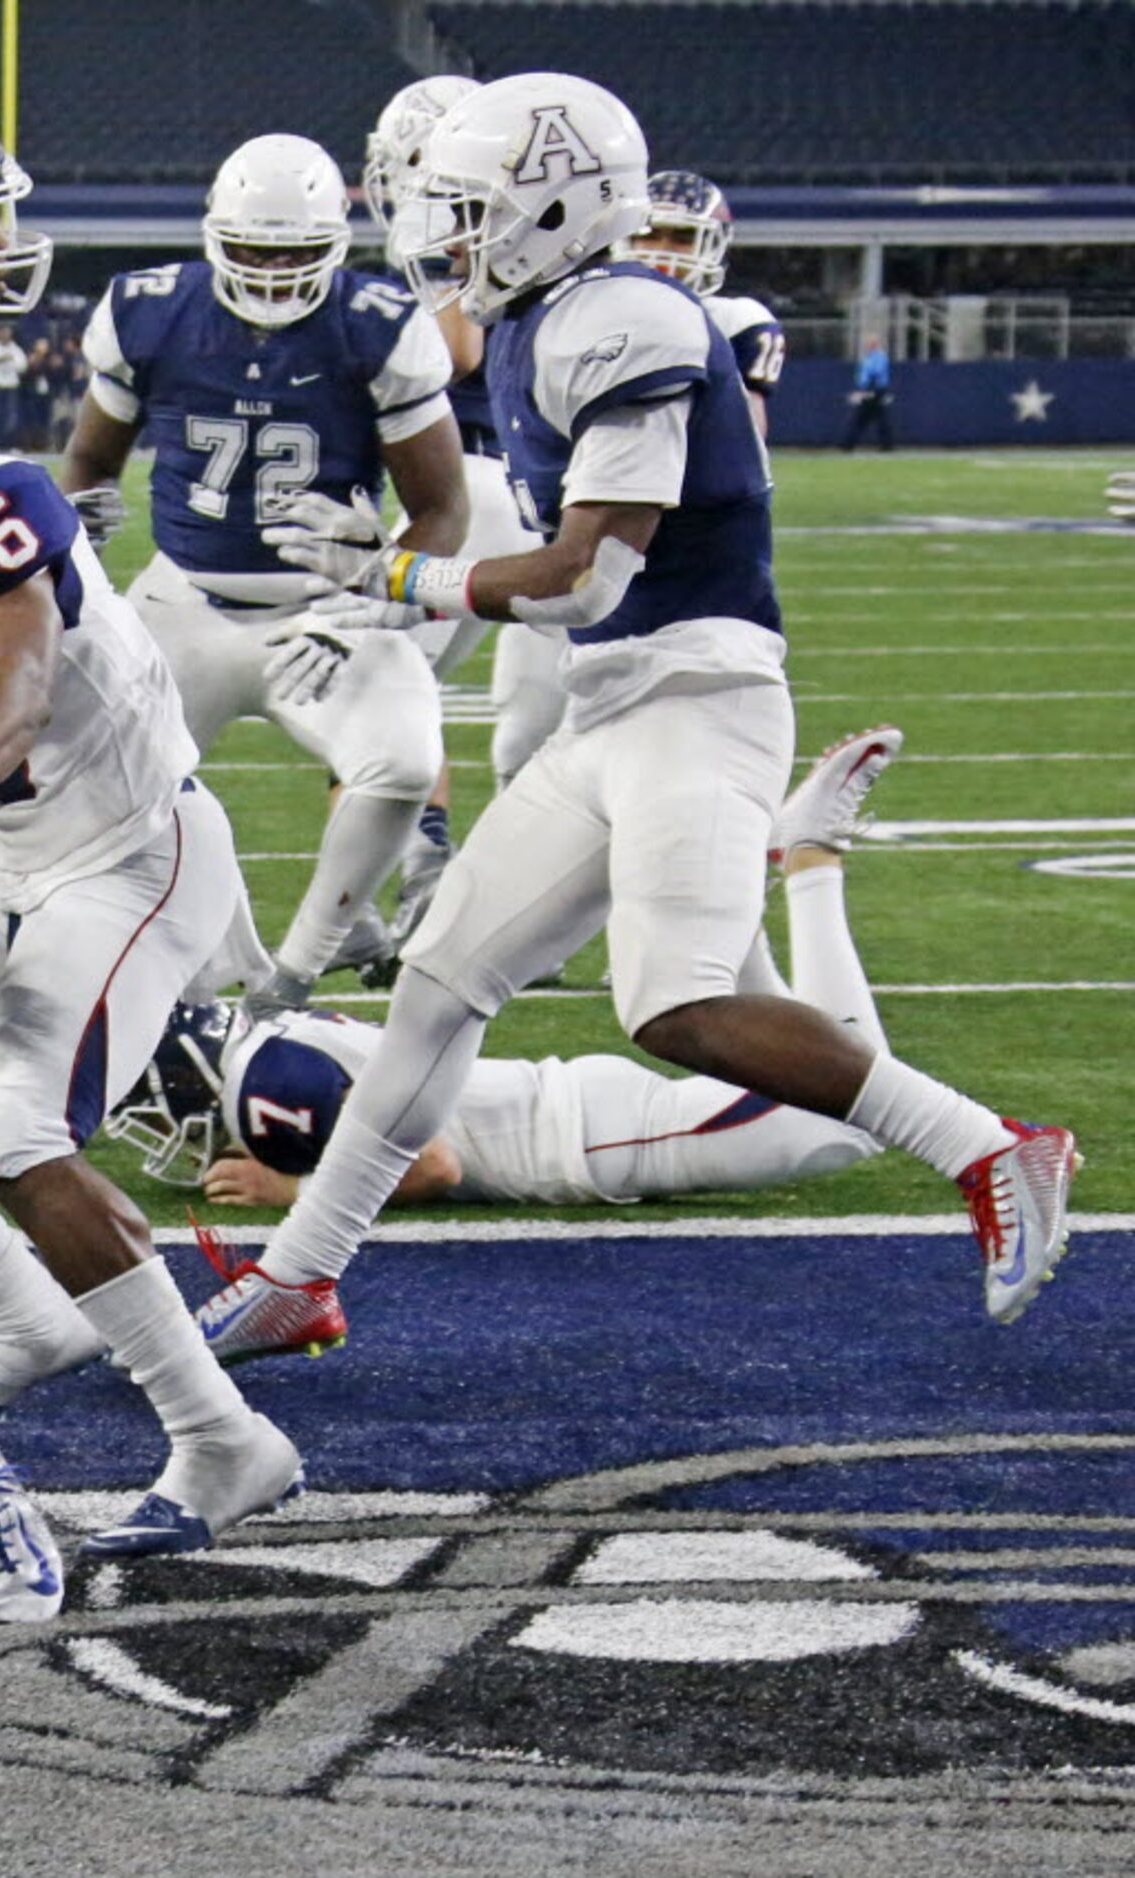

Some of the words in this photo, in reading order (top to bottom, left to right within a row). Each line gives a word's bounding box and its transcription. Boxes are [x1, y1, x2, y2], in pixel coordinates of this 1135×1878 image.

[514, 106, 601, 184] A
[600, 180, 612, 200] 5
[185, 415, 320, 524] 72
[246, 1095, 313, 1136] 7
